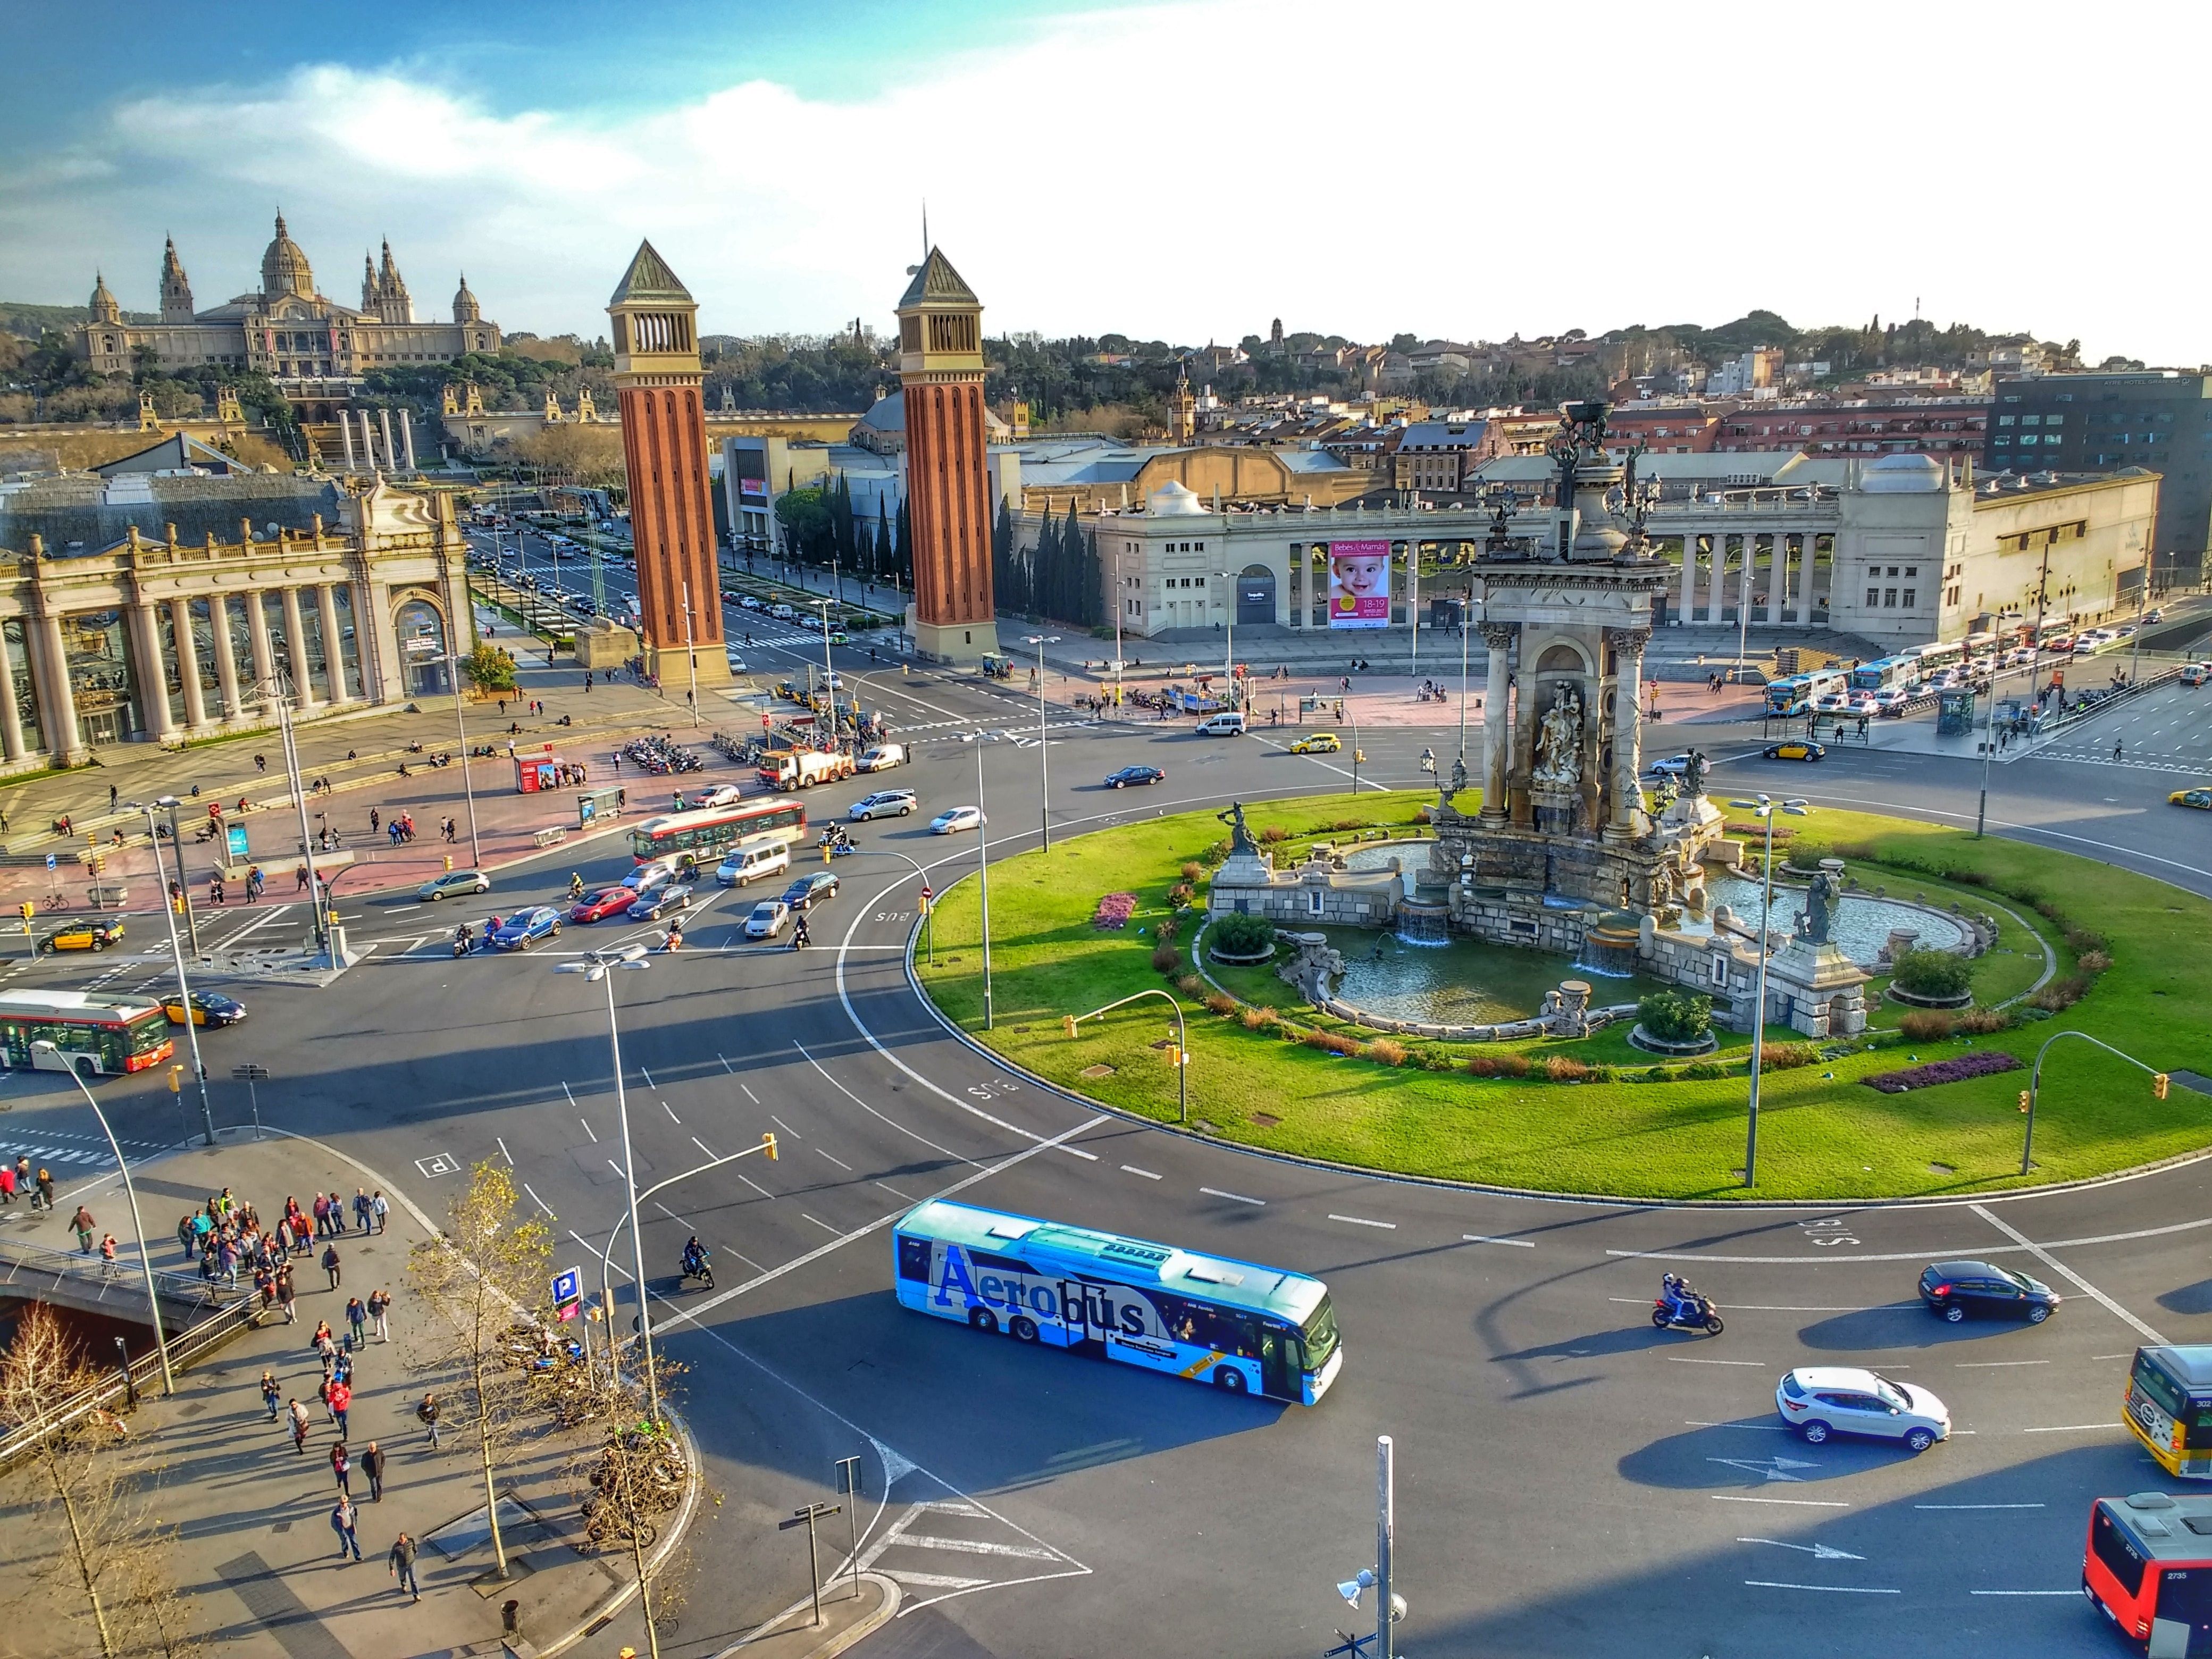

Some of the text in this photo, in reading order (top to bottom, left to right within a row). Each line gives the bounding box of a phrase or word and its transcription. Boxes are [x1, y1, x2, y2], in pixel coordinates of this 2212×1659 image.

[1363, 599, 1385, 608] 18-19
[875, 912, 910, 921] BUS
[1796, 1219, 1861, 1245] BUS
[558, 1278, 571, 1297] P
[2125, 1544, 2138, 1559] 2735
